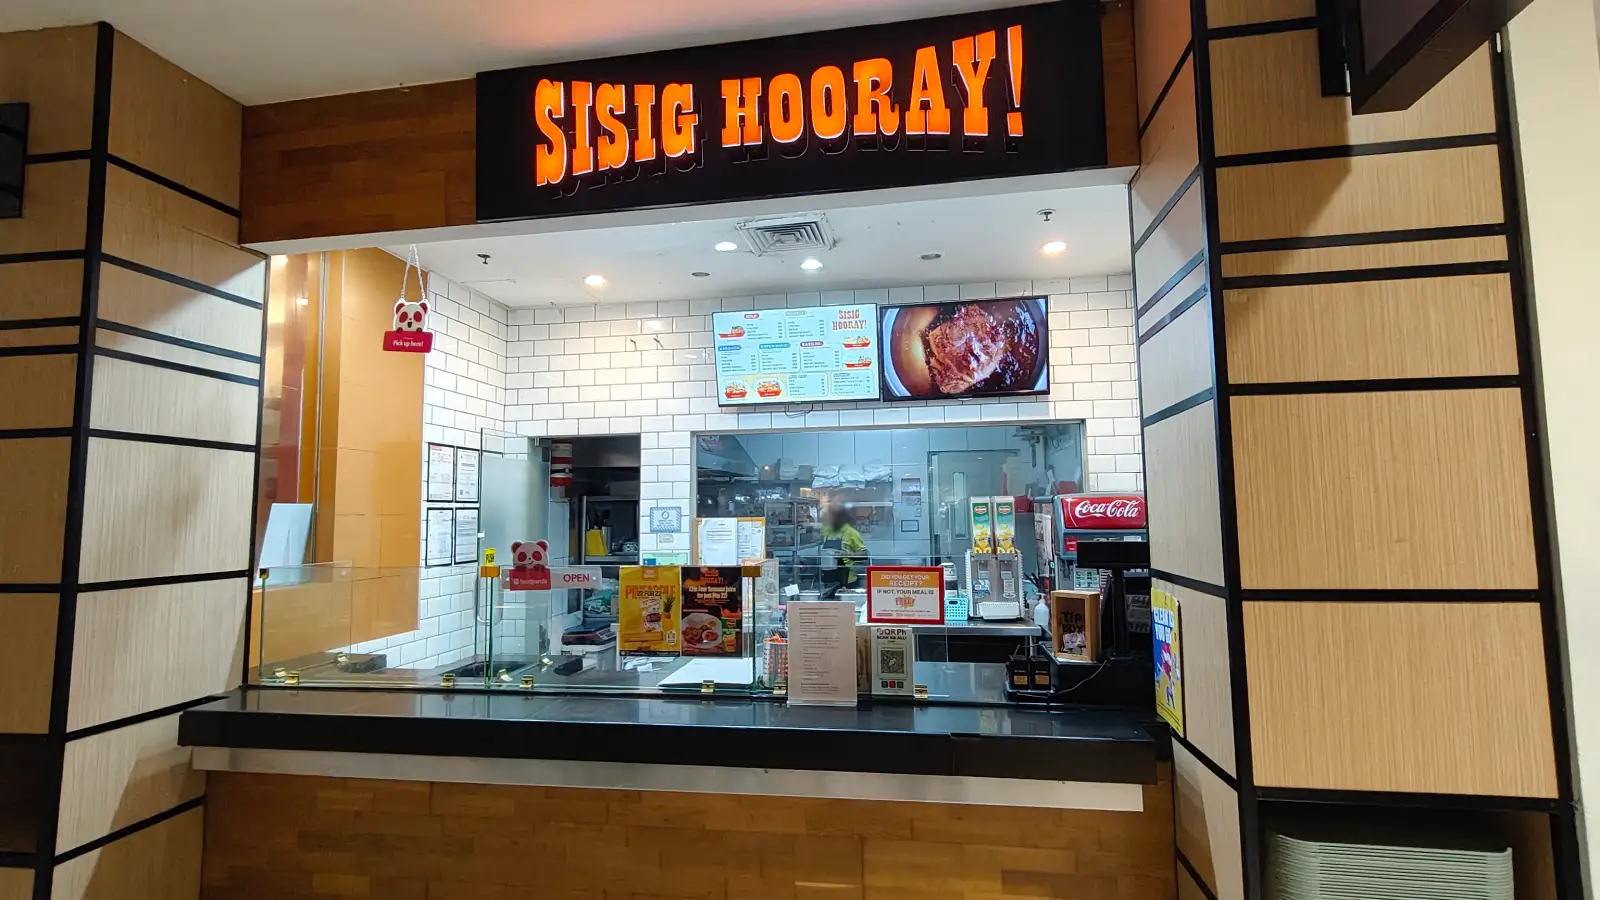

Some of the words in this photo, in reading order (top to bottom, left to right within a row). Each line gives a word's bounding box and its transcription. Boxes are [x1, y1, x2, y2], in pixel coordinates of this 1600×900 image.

[535, 78, 698, 187] SISIG
[720, 24, 1024, 148] HOORAY!
[838, 309, 860, 320] SISIG
[832, 319, 868, 331] HOORAY!
[1074, 499, 1141, 518] Coca-Cola
[520, 577, 548, 585] foodpanda
[563, 573, 590, 583] OPEN
[1061, 611, 1083, 623] TIP
[1061, 623, 1085, 634] BOX
